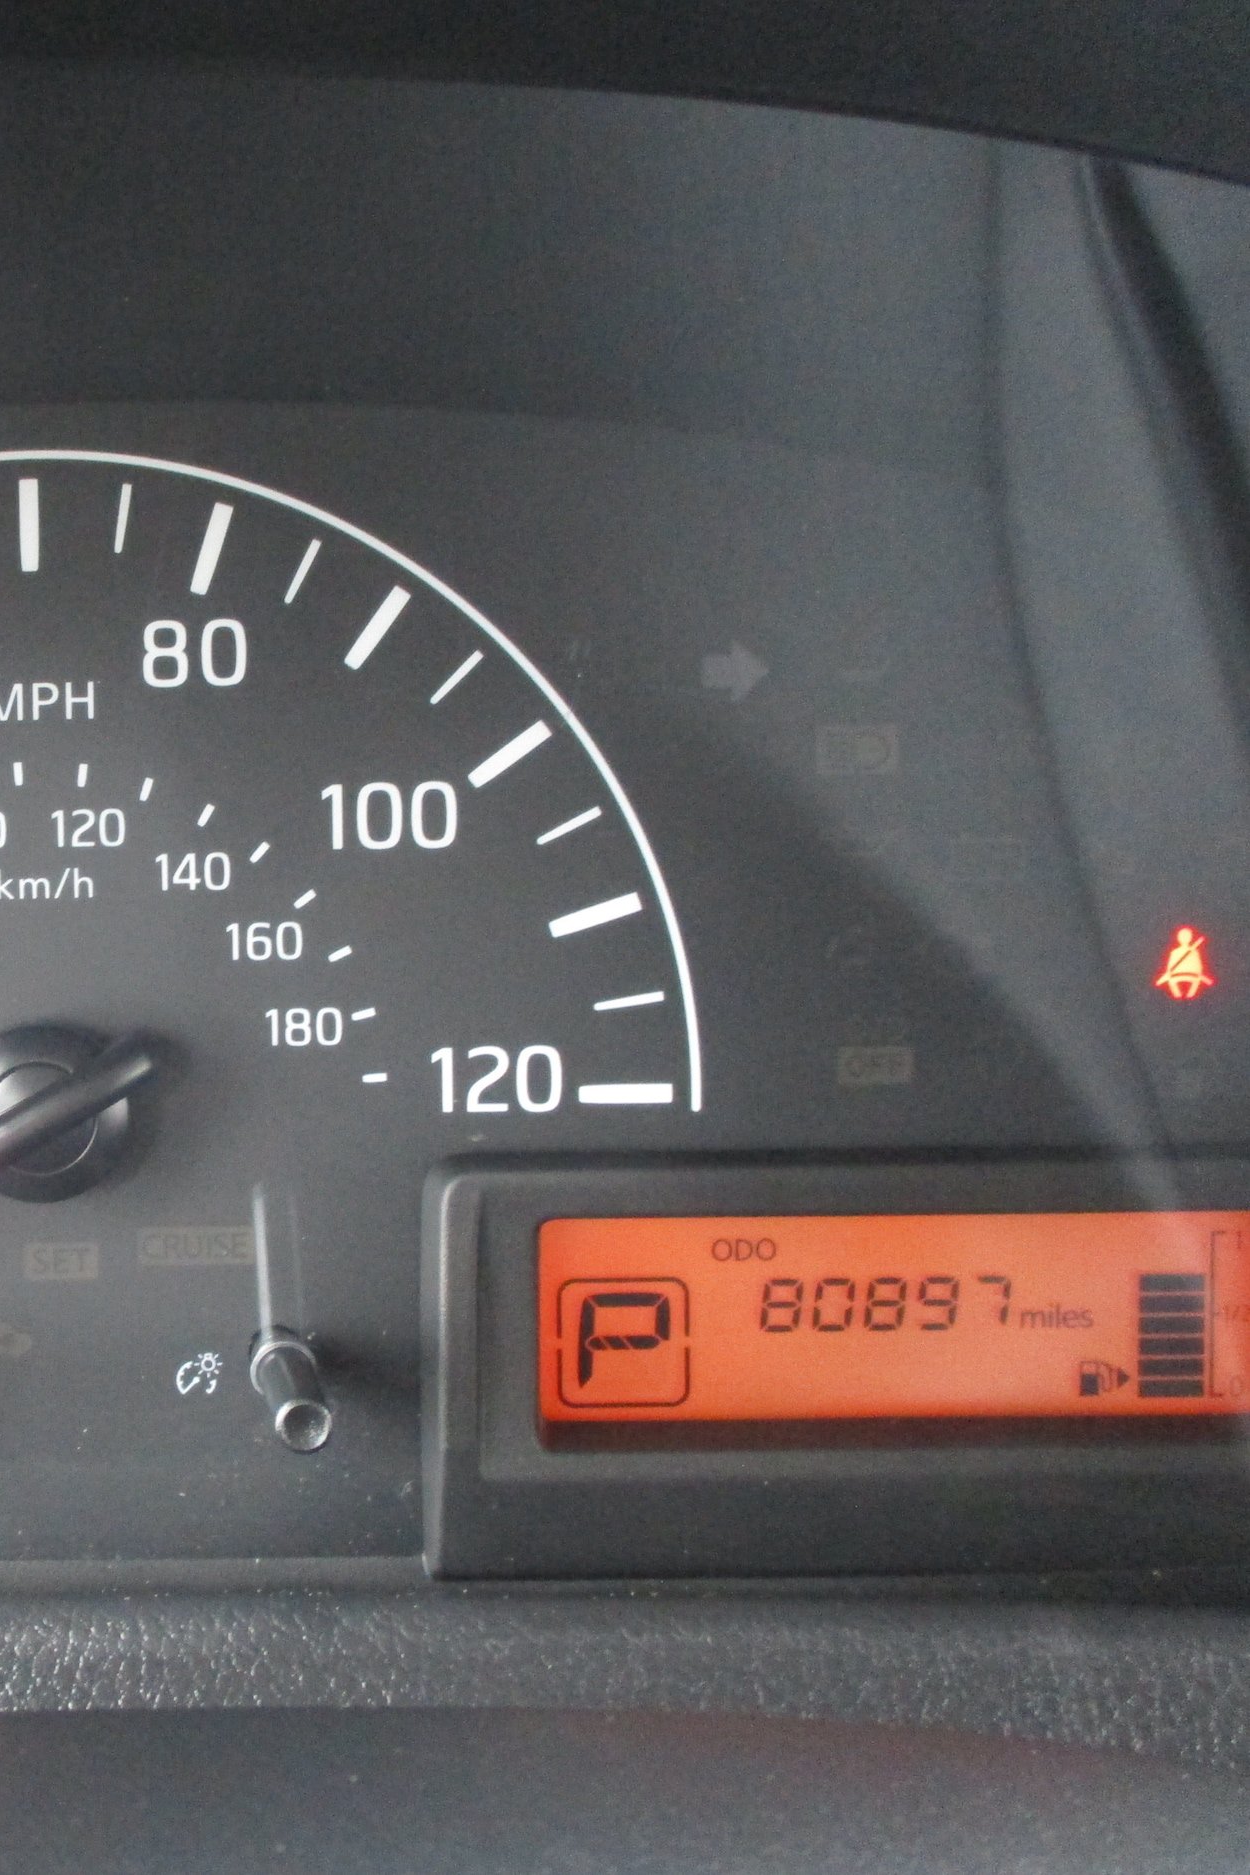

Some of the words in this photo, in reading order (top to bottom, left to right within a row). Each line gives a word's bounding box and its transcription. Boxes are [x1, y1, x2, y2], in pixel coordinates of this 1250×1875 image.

[142, 618, 247, 688] 80
[51, 808, 126, 848] 120
[321, 780, 458, 850] 100
[155, 851, 231, 891] 140
[226, 921, 303, 961] 160
[265, 1007, 343, 1047] 180
[431, 1044, 563, 1113] 120
[31, 1247, 91, 1274] SET
[141, 1232, 248, 1260] CRUISE
[711, 1237, 778, 1262] ODO
[760, 1275, 1012, 1334] 80897
[1020, 1304, 1094, 1329] miles
[577, 1292, 671, 1386] P
